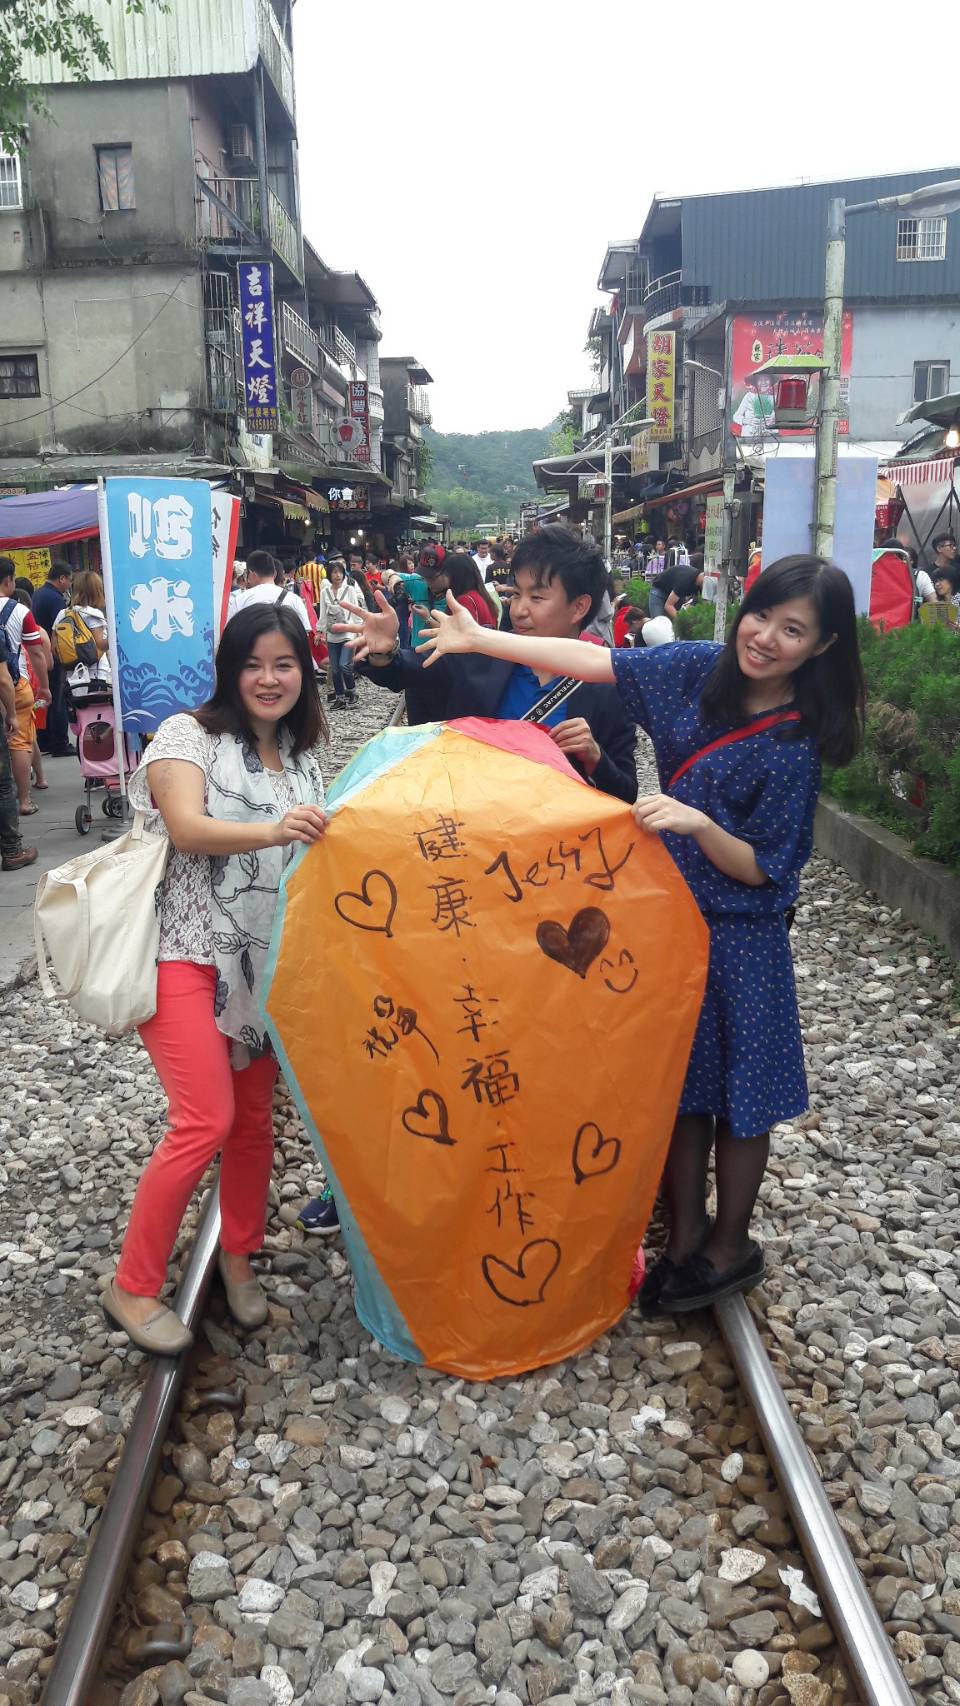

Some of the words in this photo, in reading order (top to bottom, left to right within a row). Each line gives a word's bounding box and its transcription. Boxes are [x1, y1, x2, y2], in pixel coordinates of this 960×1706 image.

[245, 266, 273, 403] 吉祥天燈
[413, 814, 477, 937] 健康
[453, 984, 520, 1108] 幸福
[484, 1141, 537, 1236] 工作
